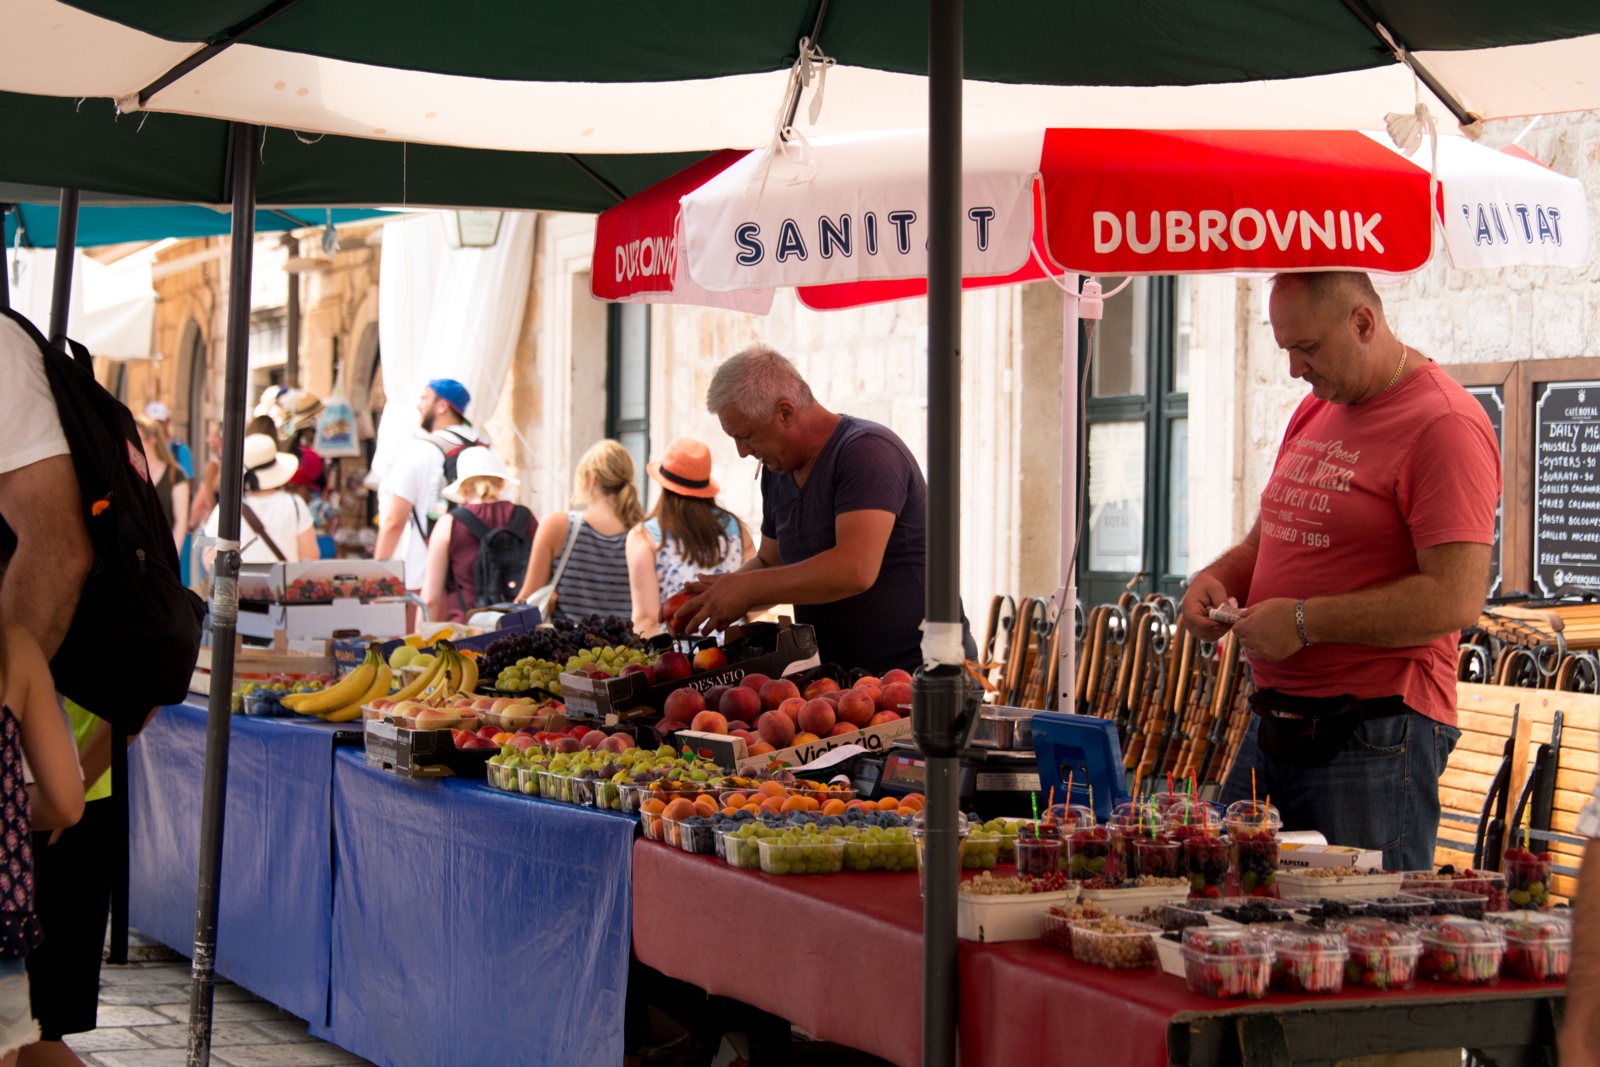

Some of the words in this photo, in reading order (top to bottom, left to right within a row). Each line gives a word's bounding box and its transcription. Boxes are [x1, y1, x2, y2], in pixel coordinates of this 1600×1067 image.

[734, 206, 995, 267] SANITT
[1092, 207, 1385, 255] DUBROVNIK
[1549, 423, 1579, 445] DAILY
[1325, 440, 1360, 464] Goods
[1542, 441, 1577, 453] MUSSELS
[1543, 456, 1581, 471] OYSTERS
[1309, 460, 1355, 492] WEAR
[1542, 470, 1578, 482] BURRATA
[1542, 484, 1569, 495] GRILLED
[1309, 492, 1332, 514] CO.
[1542, 498, 1565, 509] FRIED
[1542, 513, 1565, 525] PASTA
[1301, 531, 1331, 548] 1969
[1541, 529, 1568, 541] GRILLED
[1540, 552, 1561, 564] FREE
[687, 668, 745, 692] DESAFIO
[1279, 859, 1310, 867] PAPSTAR
